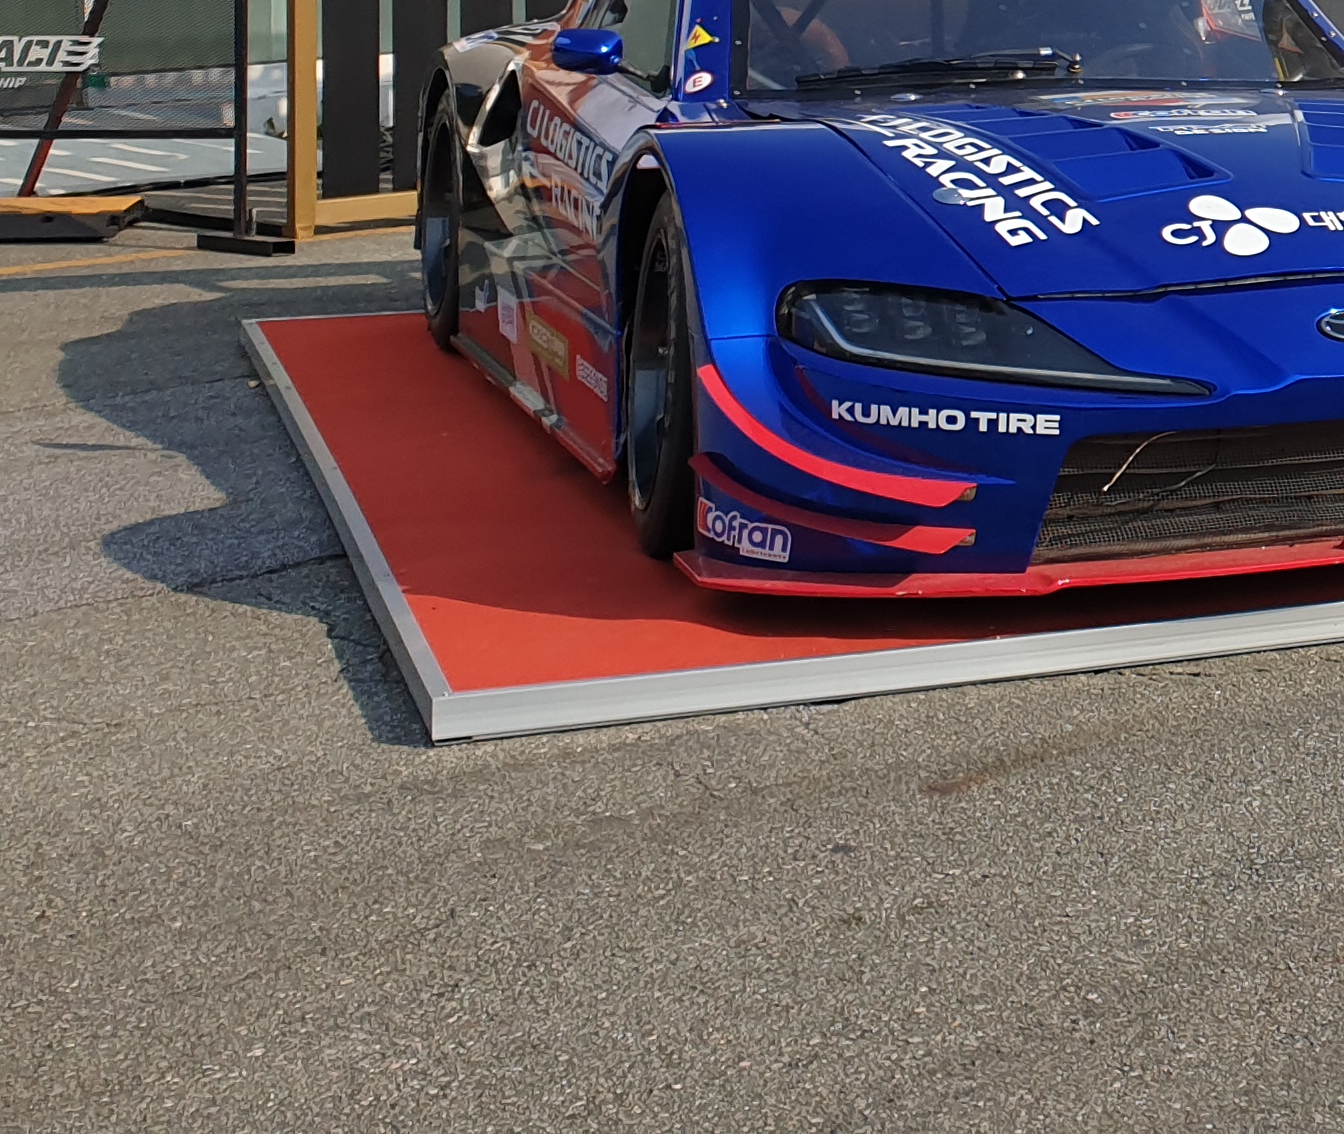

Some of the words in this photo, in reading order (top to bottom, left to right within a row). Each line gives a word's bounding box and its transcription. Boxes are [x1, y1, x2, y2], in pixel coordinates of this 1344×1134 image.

[540, 109, 614, 192] LOGISTICS
[896, 121, 1100, 235] LOGISTICS
[882, 138, 1049, 247] RACING
[1161, 220, 1217, 247] CJ
[831, 399, 966, 431] KUMHO
[970, 411, 1062, 435] TIRE
